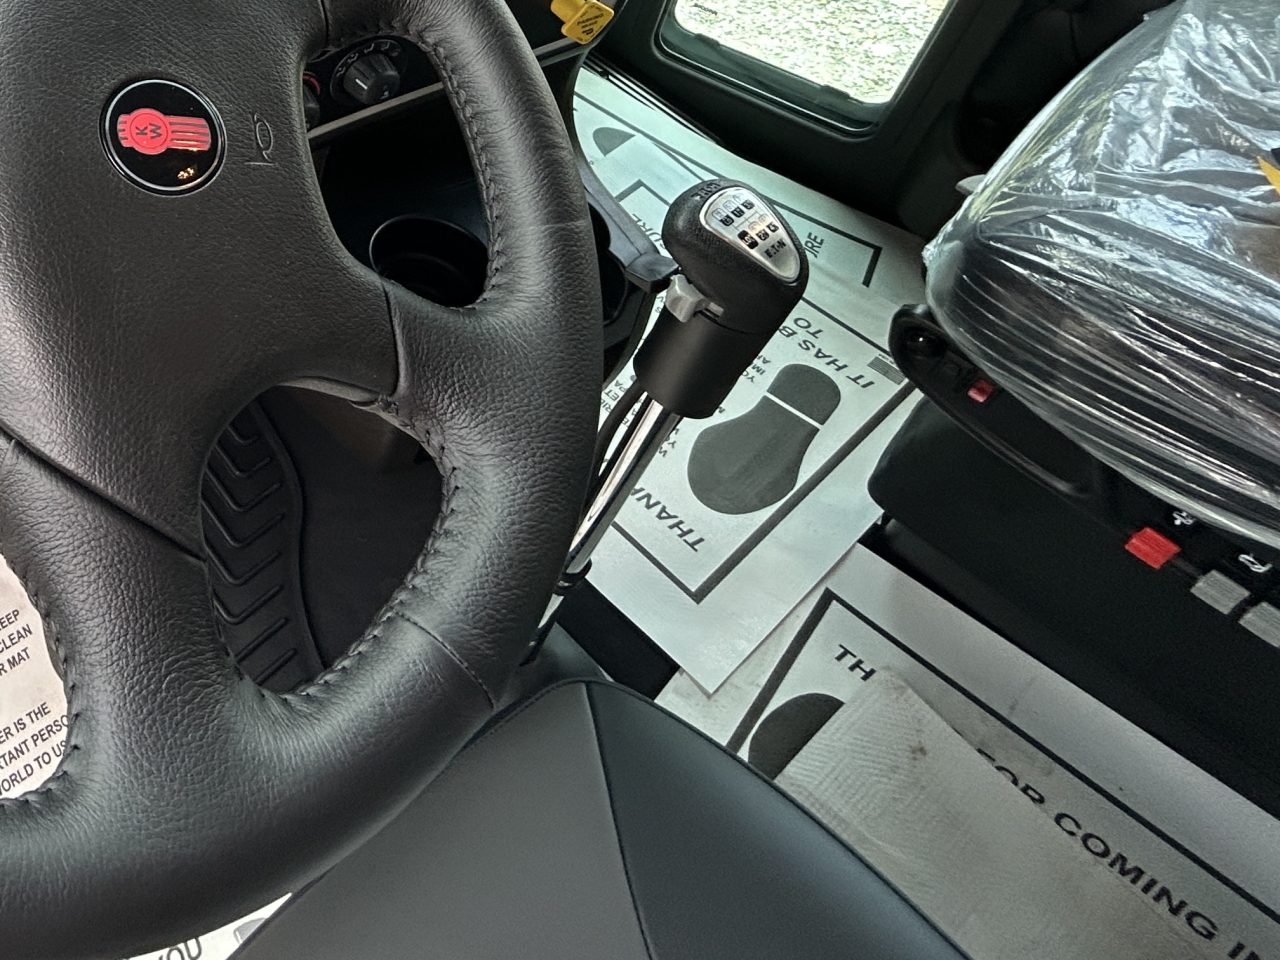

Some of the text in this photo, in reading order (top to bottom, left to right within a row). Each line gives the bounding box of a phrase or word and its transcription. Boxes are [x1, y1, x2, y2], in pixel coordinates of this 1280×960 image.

[793, 317, 823, 338] TO
[798, 339, 849, 371] HAS
[846, 374, 875, 389] IT
[6, 647, 31, 674] MAT
[14, 718, 26, 733] IS
[26, 702, 51, 724] THE
[34, 751, 52, 769] TO
[1053, 811, 1218, 941] COMING
